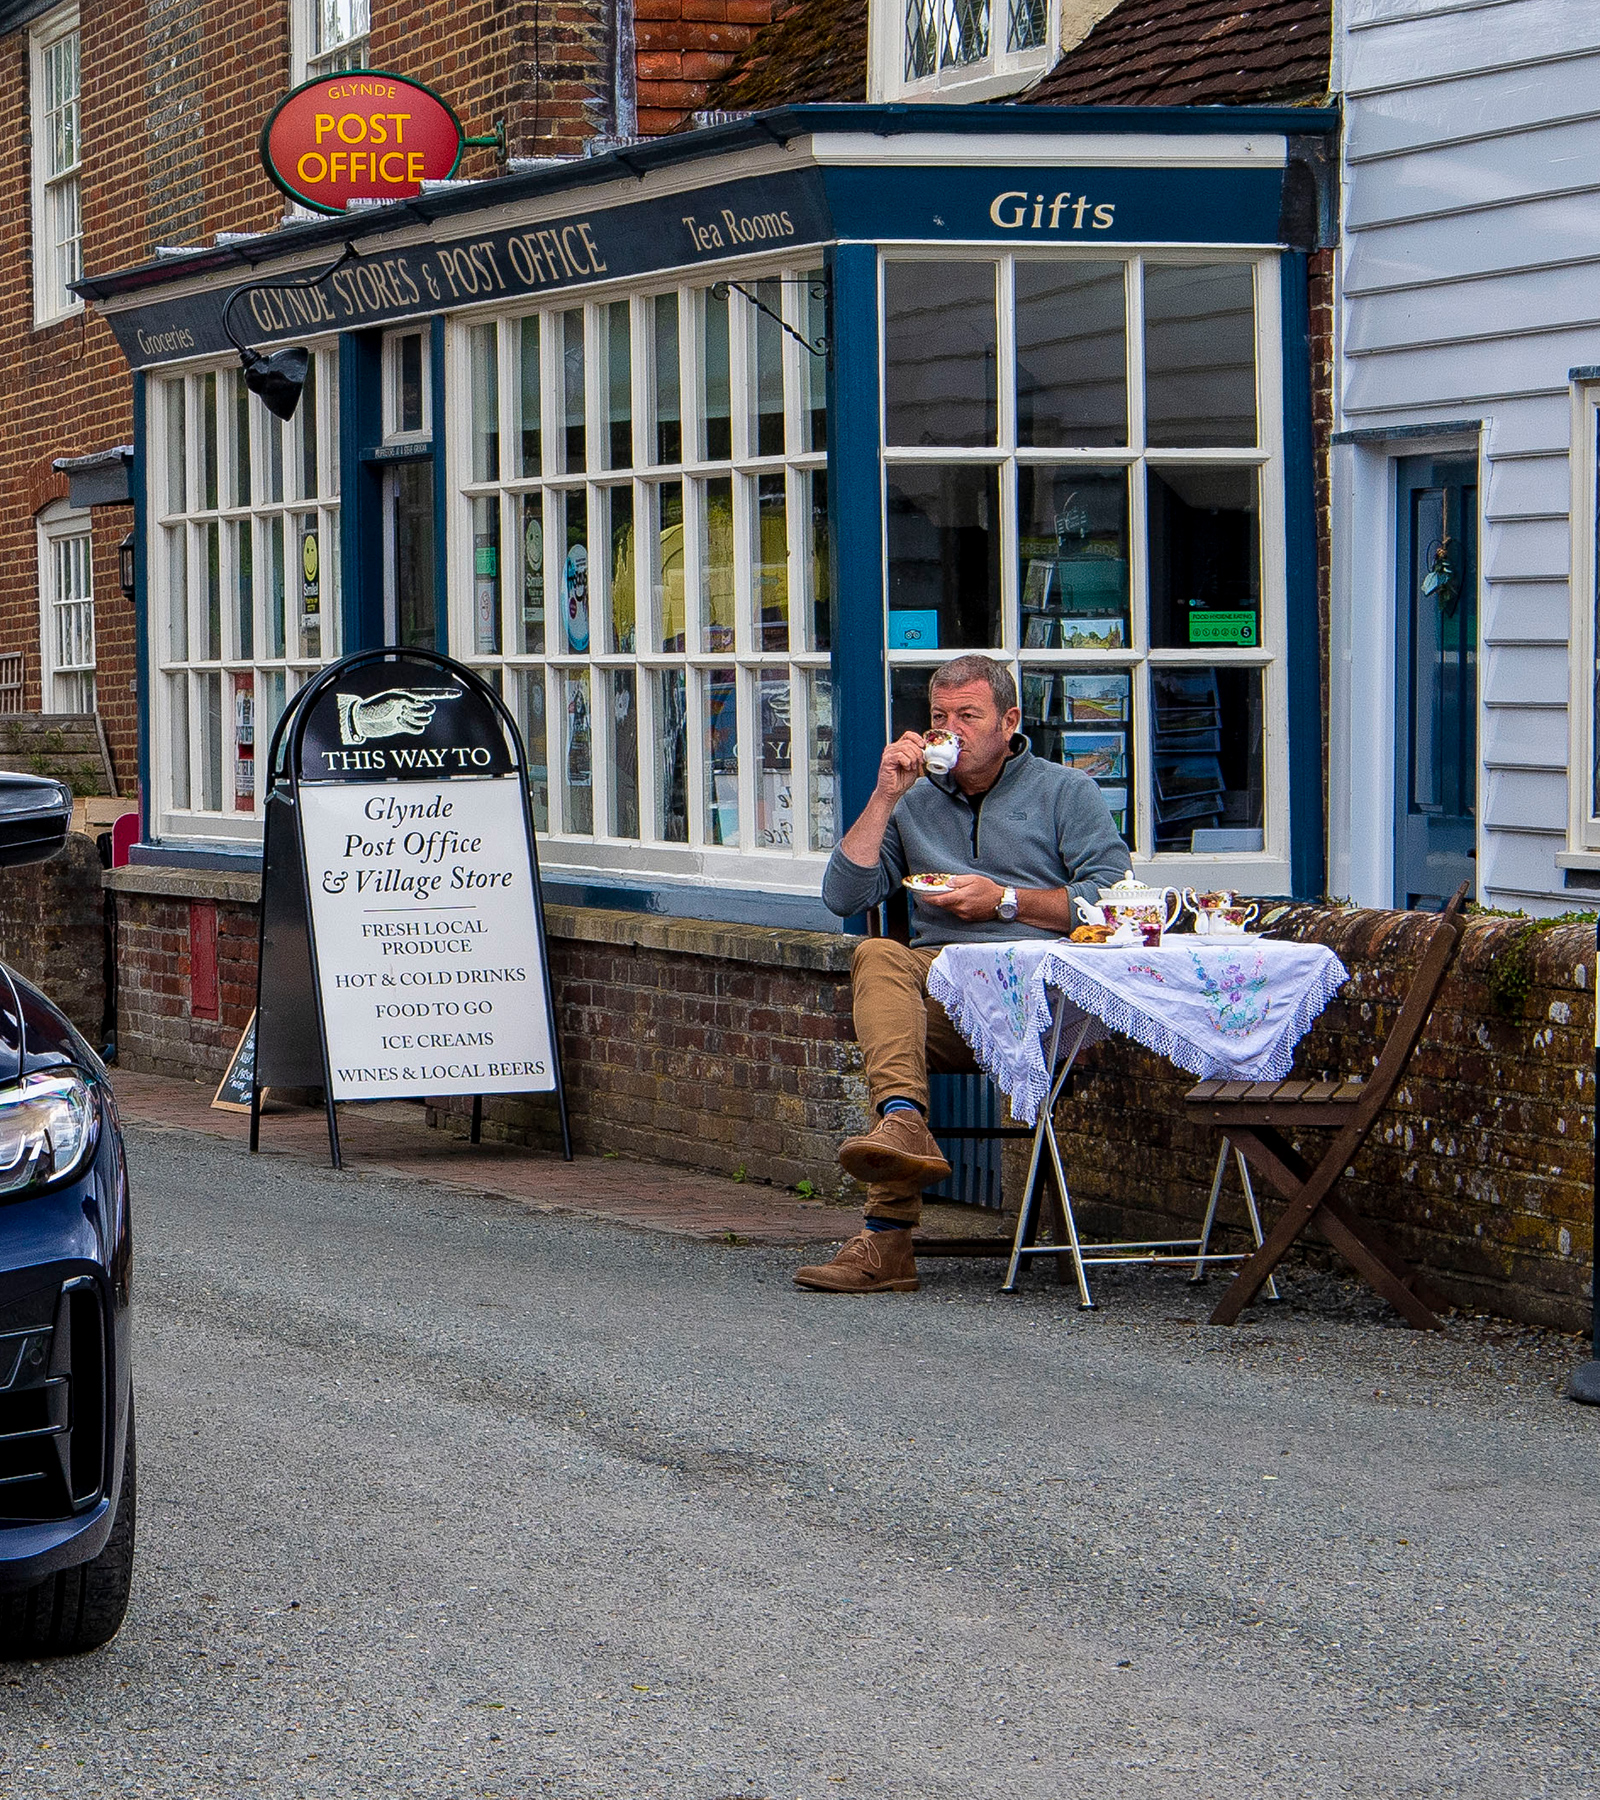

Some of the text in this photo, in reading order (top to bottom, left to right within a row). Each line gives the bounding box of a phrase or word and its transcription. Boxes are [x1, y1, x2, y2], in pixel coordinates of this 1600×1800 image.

[328, 83, 397, 100] GLYNDE
[314, 112, 412, 144] POST
[297, 151, 425, 184] OFFICE
[989, 191, 1116, 229] Gifts
[682, 210, 795, 251] Tea Rooms
[250, 222, 608, 332] GLYNDE STORES & POST OFFICE
[137, 325, 195, 358] Groceries
[1243, 627, 1250, 637] 5
[320, 747, 491, 771] THIS WAY TO
[364, 794, 454, 829] Glynde
[343, 830, 482, 864] Post Office
[322, 865, 513, 901] & Village Store
[362, 919, 488, 937] FRESH LOCAL
[382, 939, 473, 956] PRODUCE
[335, 967, 526, 988] HOT & COLD DRINKS
[375, 1000, 493, 1018] FOOD TO GO
[381, 1032, 494, 1049] ICE CREAMS
[337, 1060, 545, 1083] WINES & LOCAL BEERS
